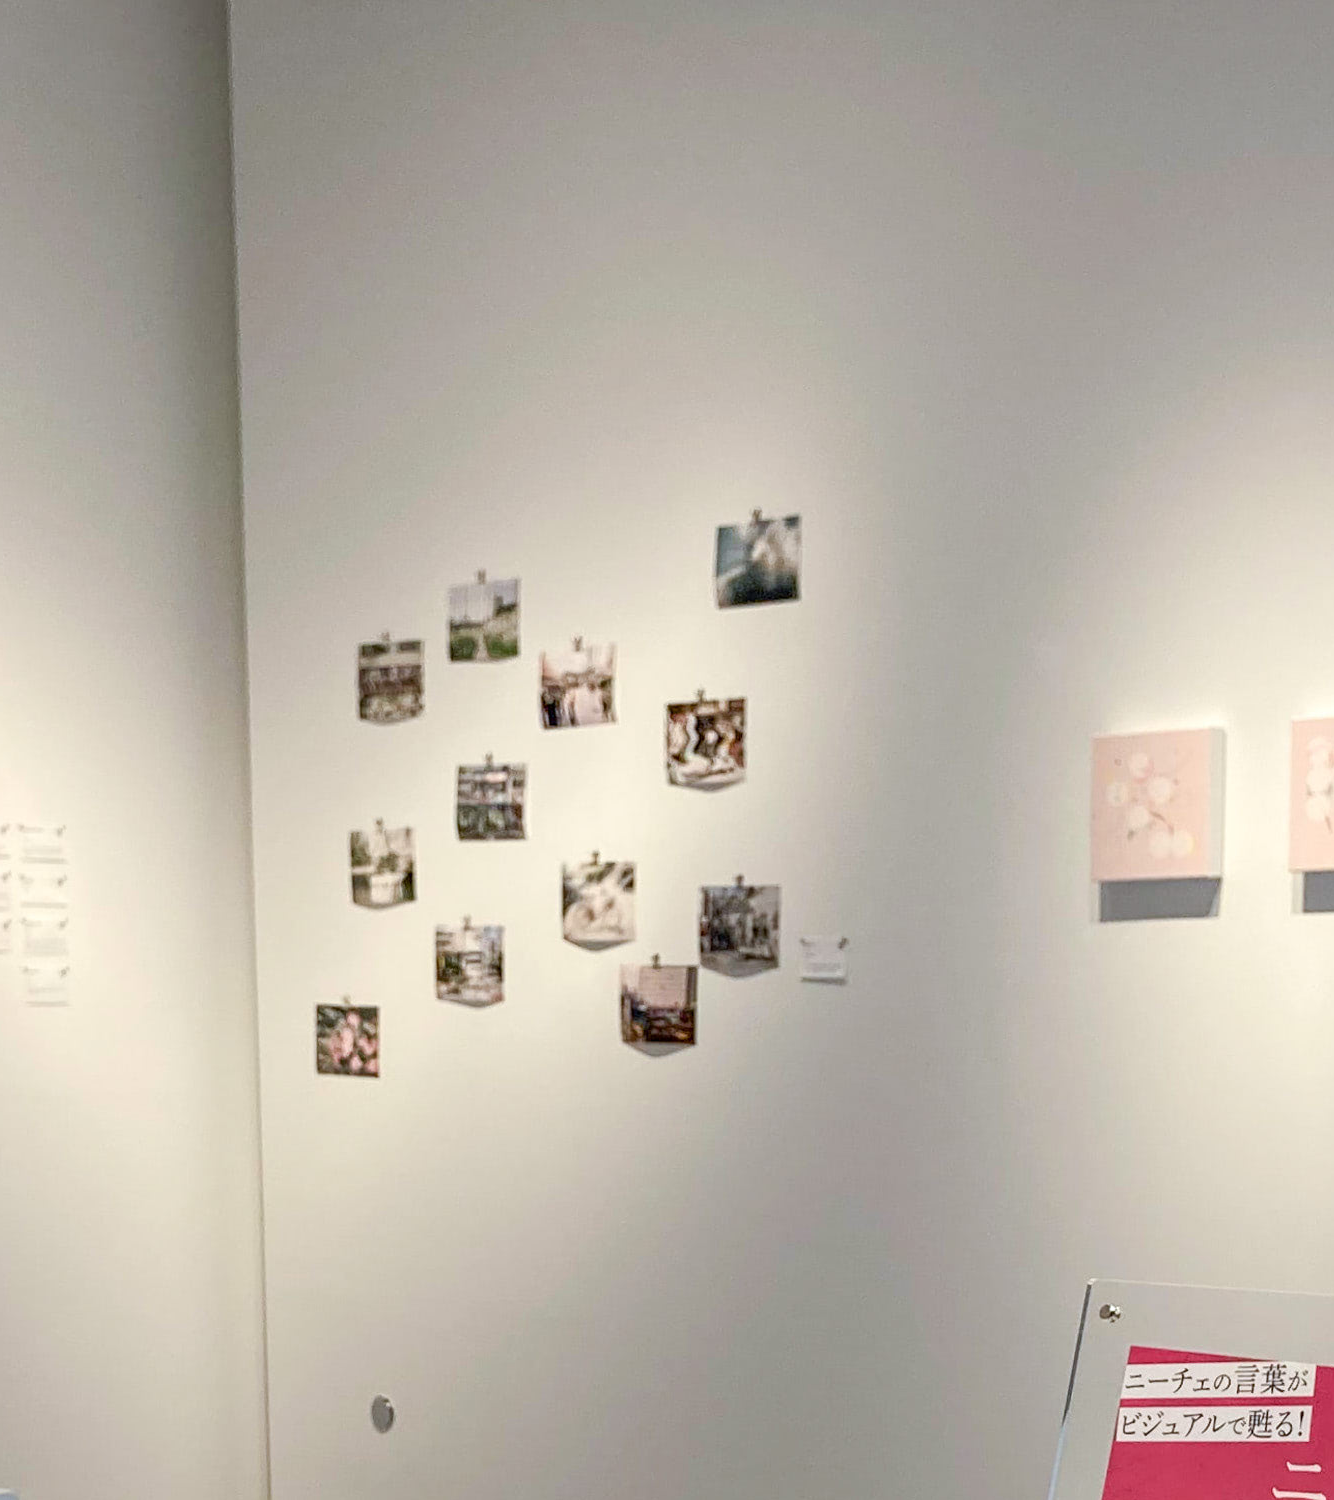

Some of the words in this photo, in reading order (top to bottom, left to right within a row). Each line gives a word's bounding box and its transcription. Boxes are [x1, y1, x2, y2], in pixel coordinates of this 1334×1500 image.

[1124, 1364, 1308, 1396] ニーチェの言葉が
